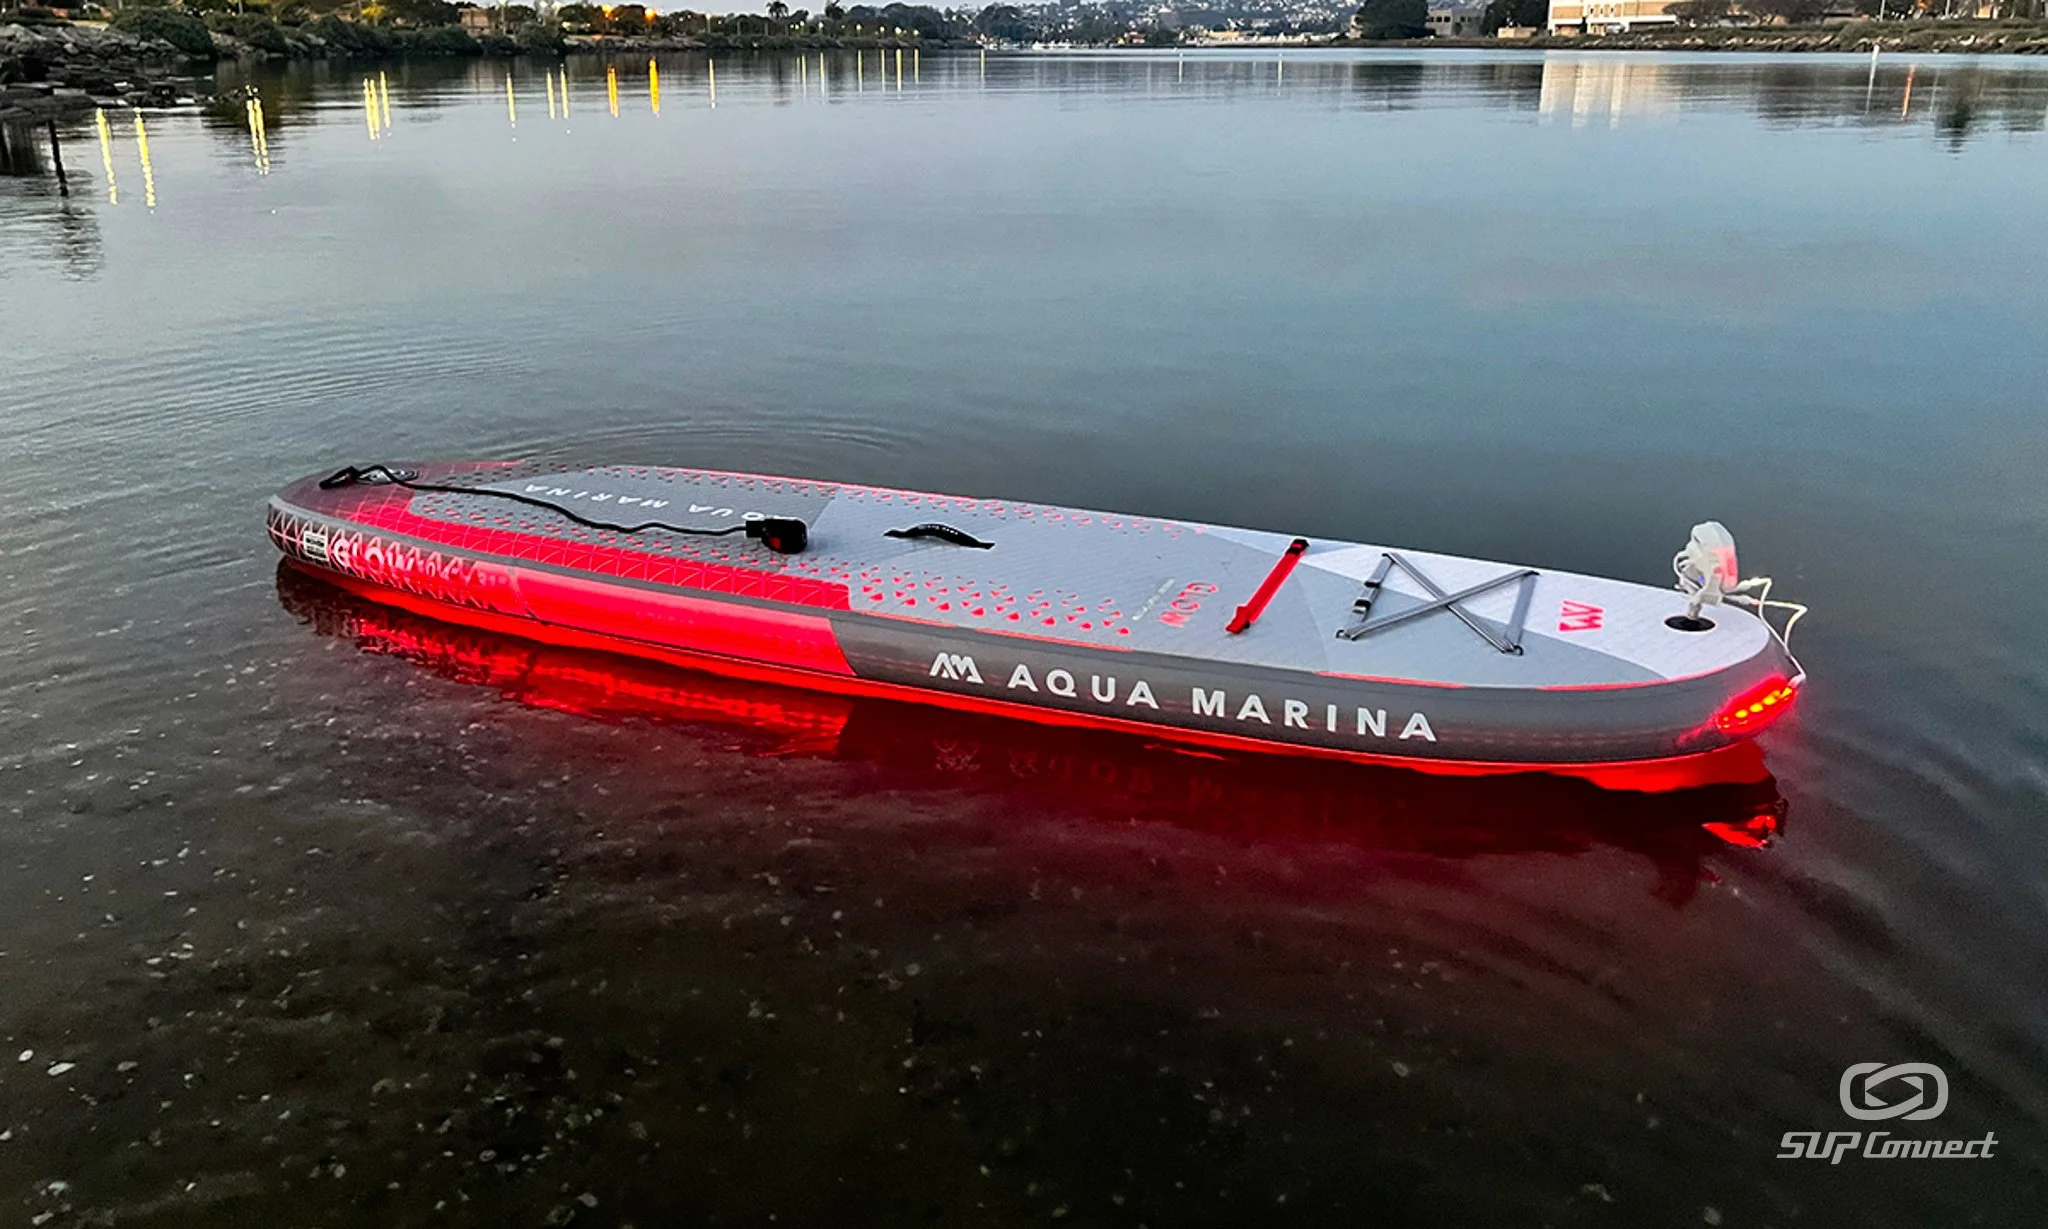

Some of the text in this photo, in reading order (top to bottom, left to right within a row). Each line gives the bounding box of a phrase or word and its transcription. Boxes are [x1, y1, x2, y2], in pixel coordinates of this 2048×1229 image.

[525, 484, 797, 520] QUA MARINA
[1007, 663, 1160, 709] AQUA
[1192, 687, 1436, 742] MARINA
